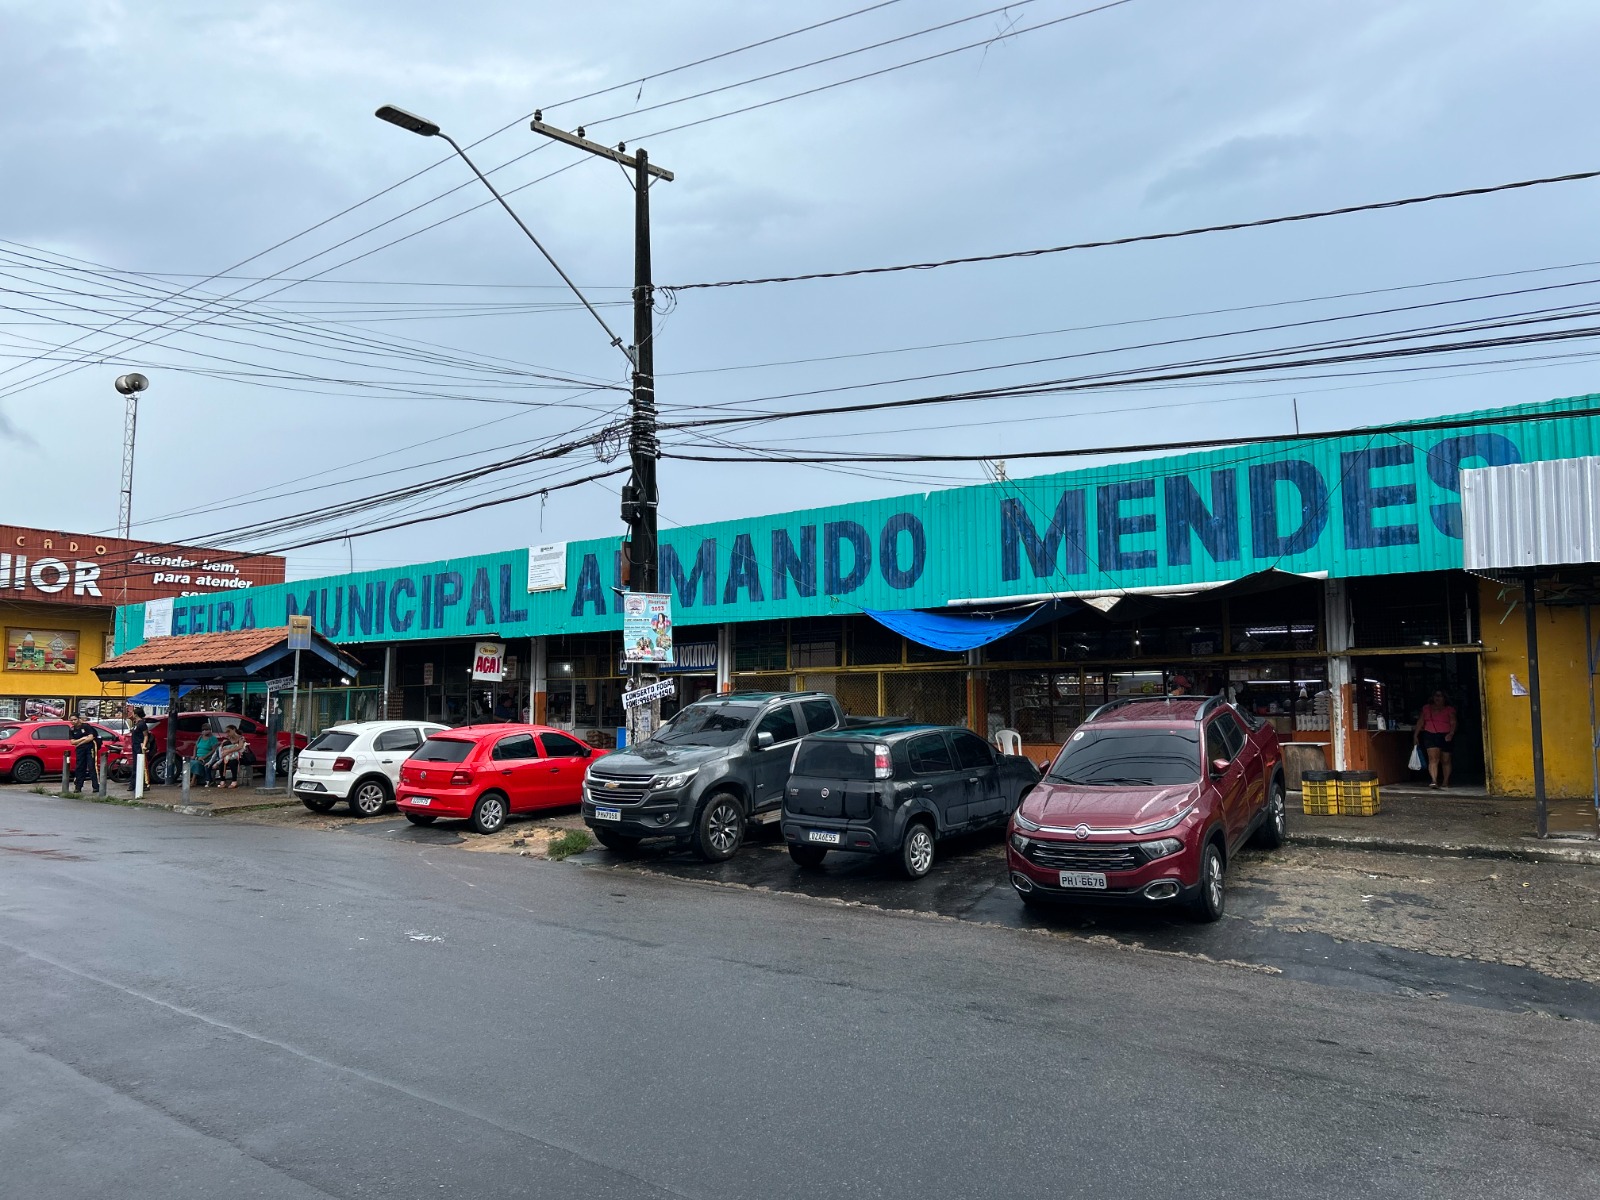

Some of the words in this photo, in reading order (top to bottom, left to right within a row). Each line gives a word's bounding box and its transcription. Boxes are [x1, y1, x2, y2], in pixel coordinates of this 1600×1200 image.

[131, 552, 198, 568] Atender
[153, 572, 191, 584] para
[195, 575, 253, 589] atender
[171, 598, 256, 636] FEIRA
[286, 563, 529, 639] MUNICIPAL
[571, 512, 927, 617] AMANDO
[680, 643, 717, 668] ROTATIVO
[625, 686, 655, 701] CONSERTO
[1061, 876, 1105, 887] PHI-6678
